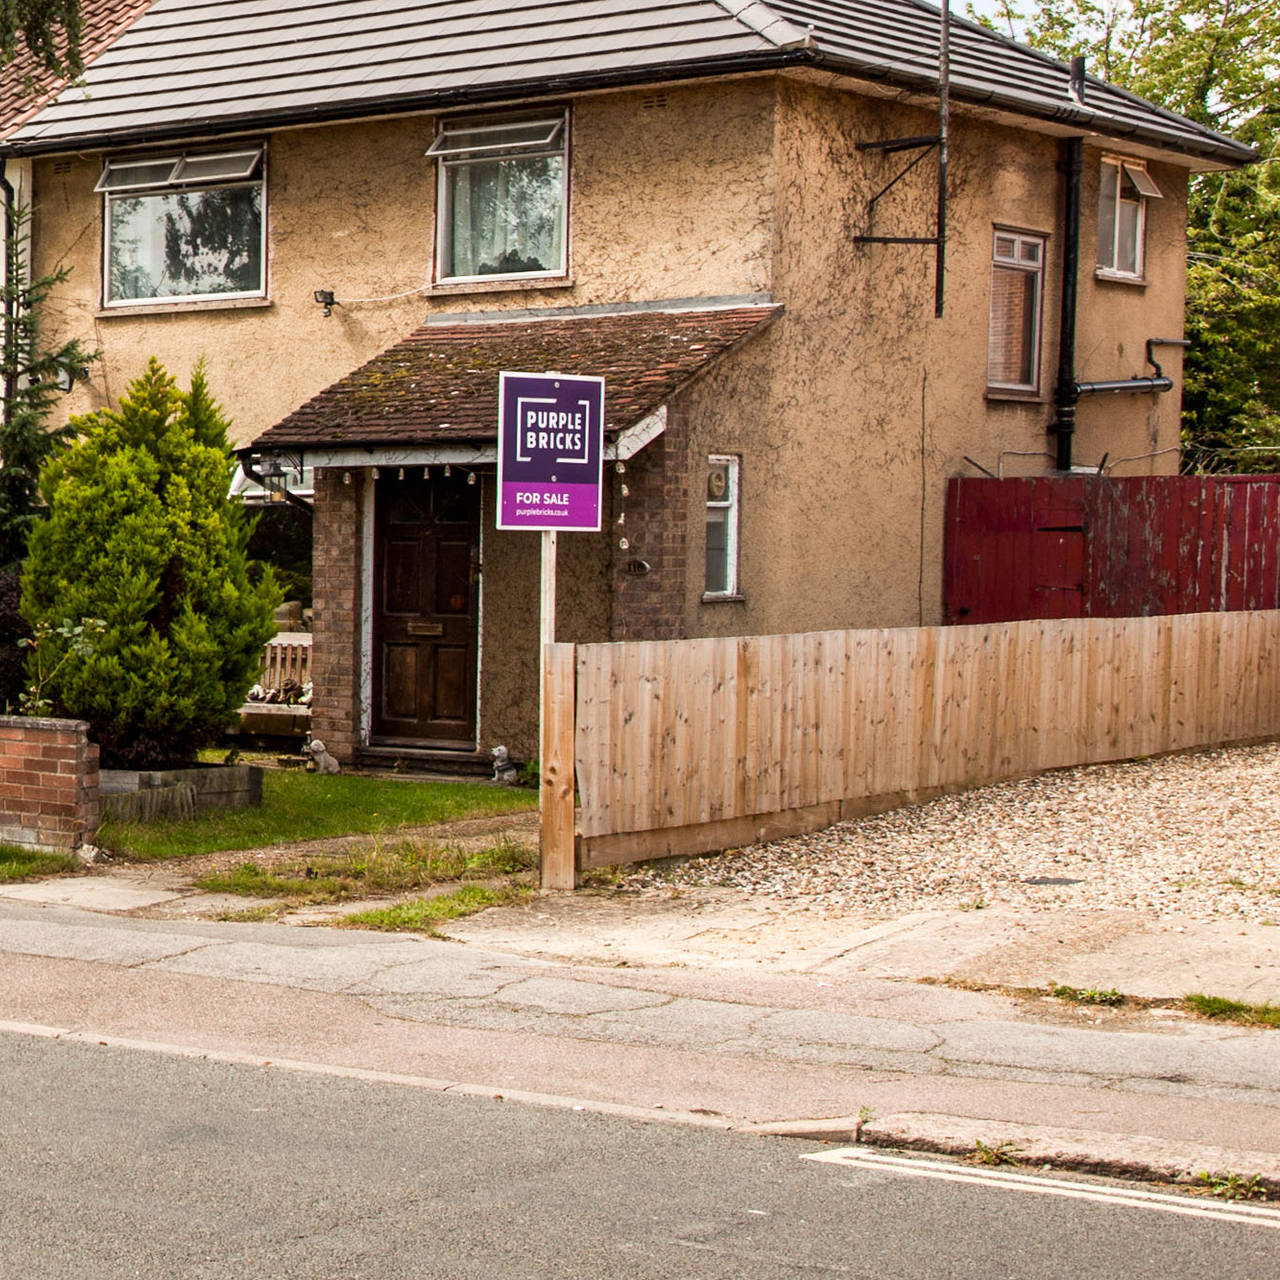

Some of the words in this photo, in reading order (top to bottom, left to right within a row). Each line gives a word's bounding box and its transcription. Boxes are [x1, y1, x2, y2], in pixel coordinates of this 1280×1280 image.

[527, 411, 582, 430] PURPLE
[527, 432, 581, 450] BRICKS
[516, 492, 540, 505] FOR
[543, 492, 569, 505] SALE
[515, 508, 569, 518] purplebricks.co.uk
